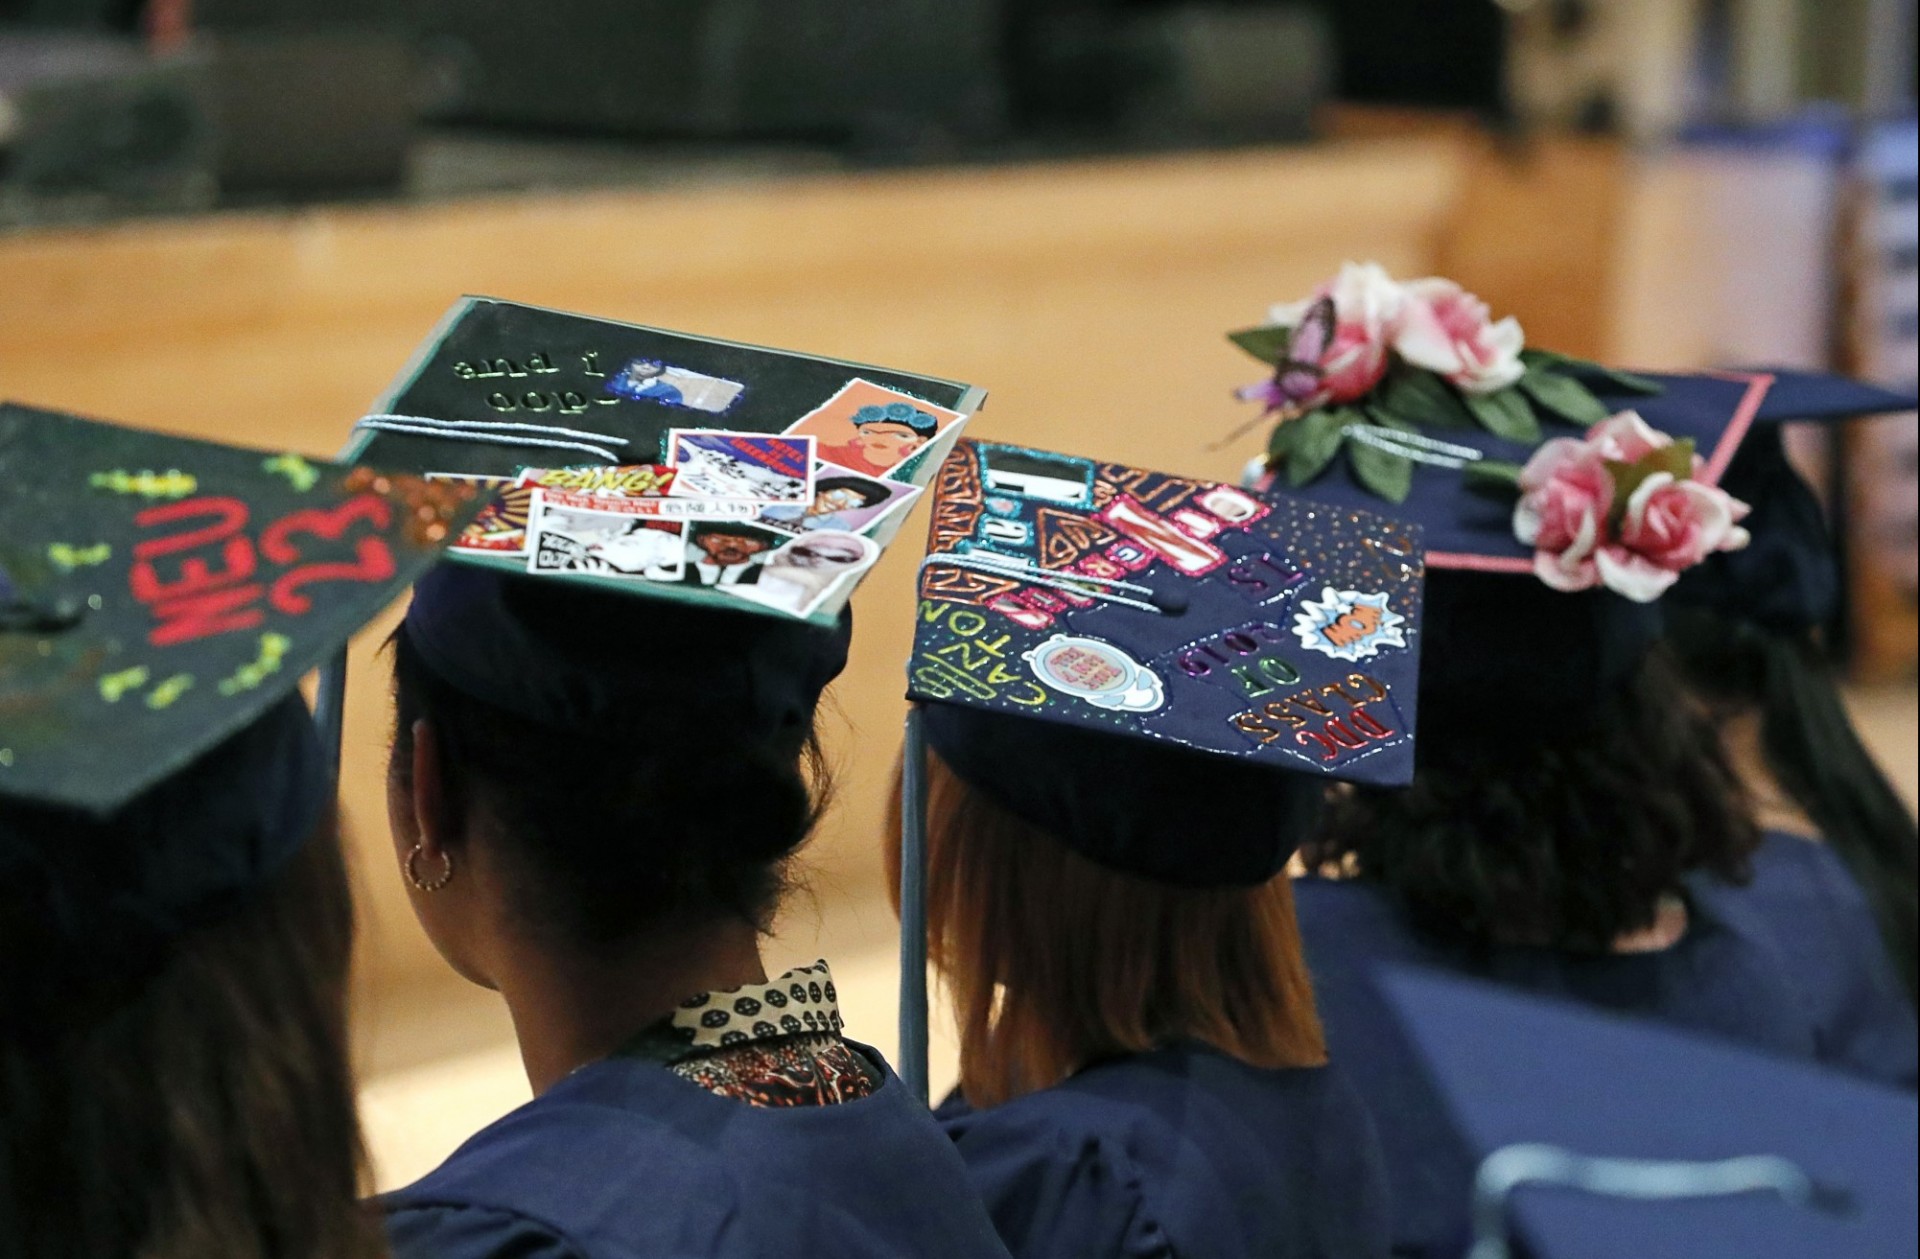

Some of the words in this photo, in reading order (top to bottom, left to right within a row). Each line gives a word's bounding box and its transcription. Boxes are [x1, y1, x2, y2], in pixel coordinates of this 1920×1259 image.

[453, 352, 560, 380] and
[485, 390, 621, 414] oop-
[538, 468, 674, 492] BANG!
[258, 494, 397, 617] 23
[1227, 552, 1304, 597] IS
[1320, 603, 1384, 648] WOW
[1178, 623, 1285, 676] 2019
[1230, 655, 1301, 698] OF
[1235, 673, 1387, 743] CLASS
[1295, 707, 1395, 761] DDC
